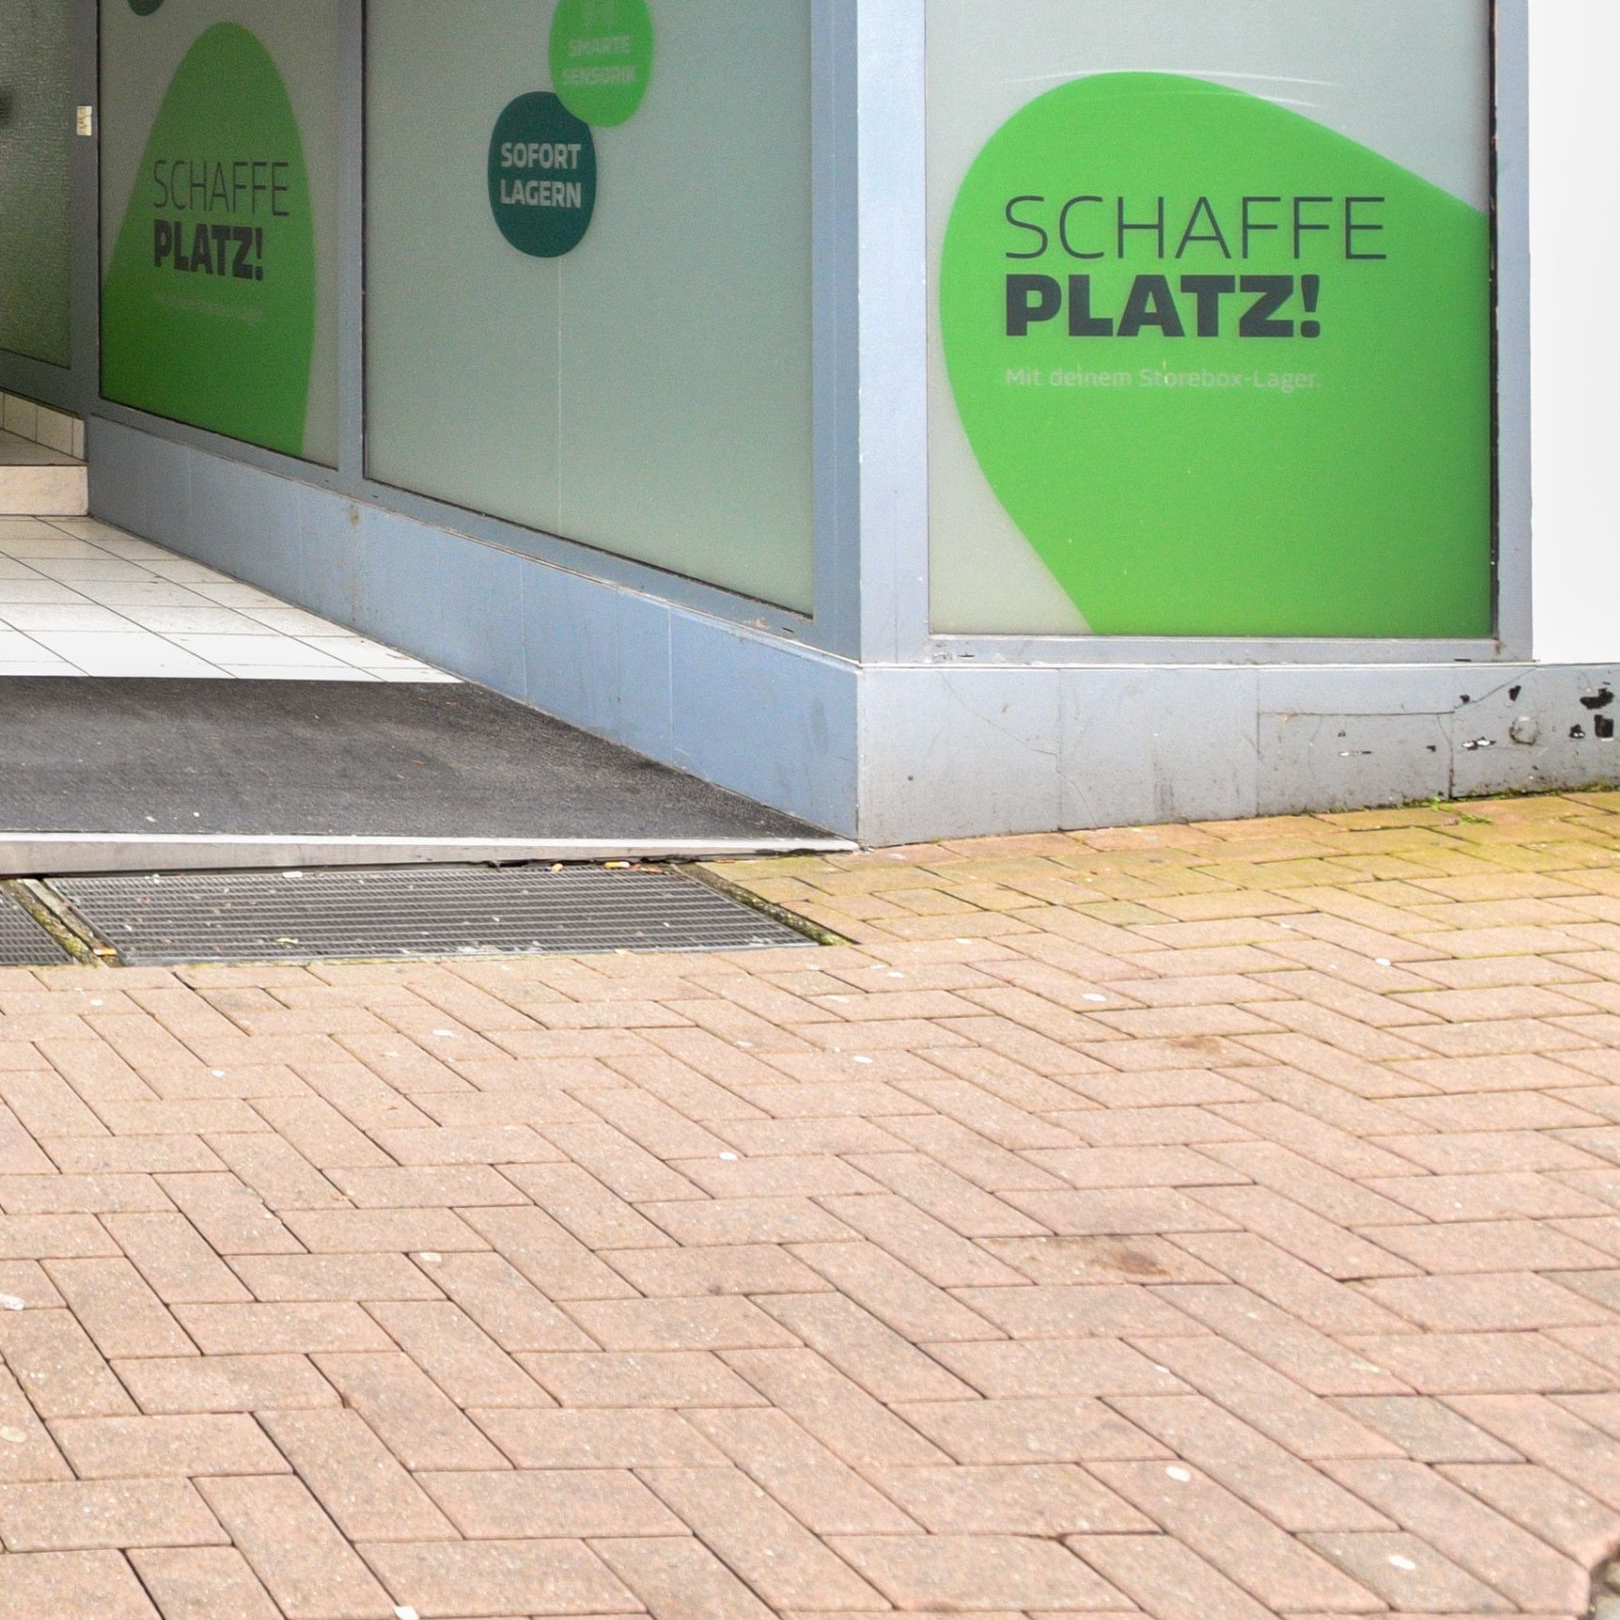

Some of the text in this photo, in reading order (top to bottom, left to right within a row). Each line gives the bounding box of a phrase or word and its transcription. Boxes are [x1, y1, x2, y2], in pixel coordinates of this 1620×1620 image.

[500, 142, 582, 170] SOFORT
[153, 160, 290, 217] SCHAFFE
[500, 178, 582, 209] LAGERN
[153, 218, 264, 281] PLATZ!
[1004, 194, 1387, 261] SCHAFFE
[1005, 273, 1322, 339] PLATZ!
[1006, 367, 1042, 387] Mit
[1049, 366, 1132, 388] deinem
